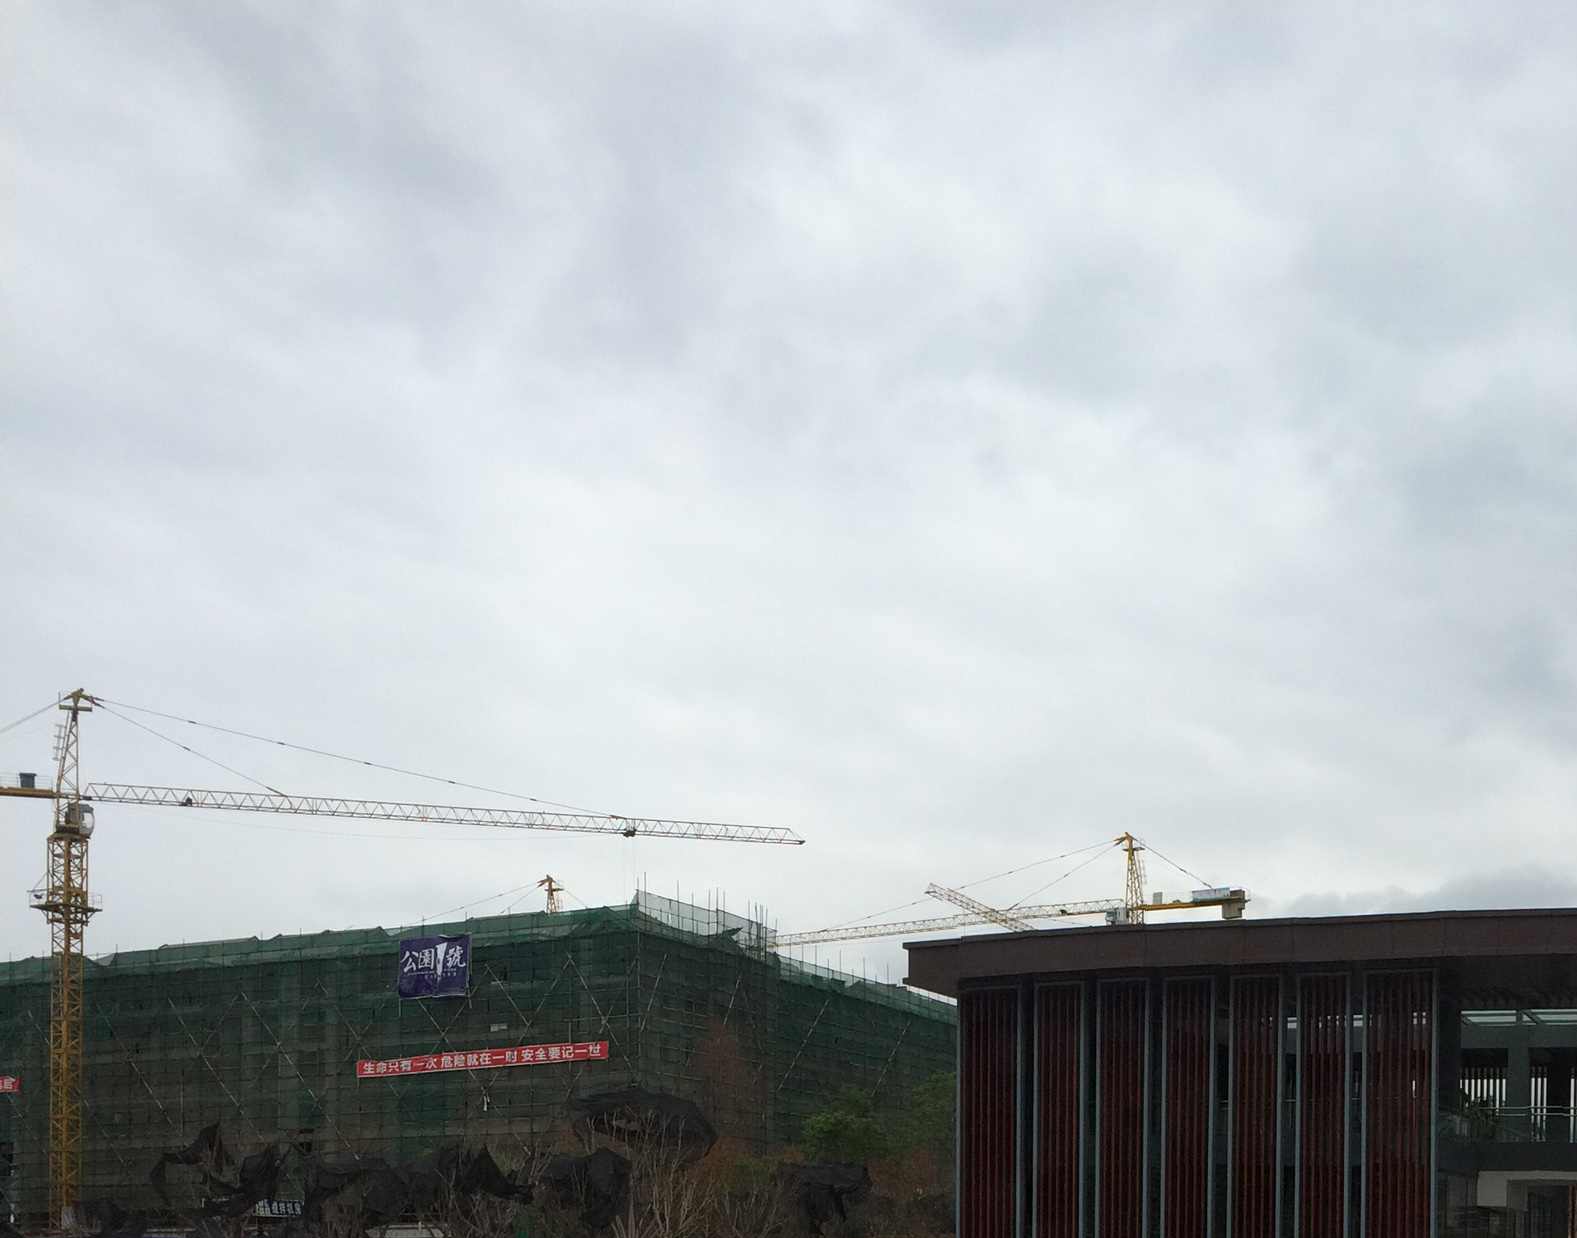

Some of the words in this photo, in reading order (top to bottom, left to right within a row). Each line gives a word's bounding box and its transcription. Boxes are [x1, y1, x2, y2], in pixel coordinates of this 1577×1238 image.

[363, 1058, 438, 1074] 生命只有一次
[441, 1051, 517, 1068] 危险就在一时
[521, 1044, 601, 1061] 安全要记一世
